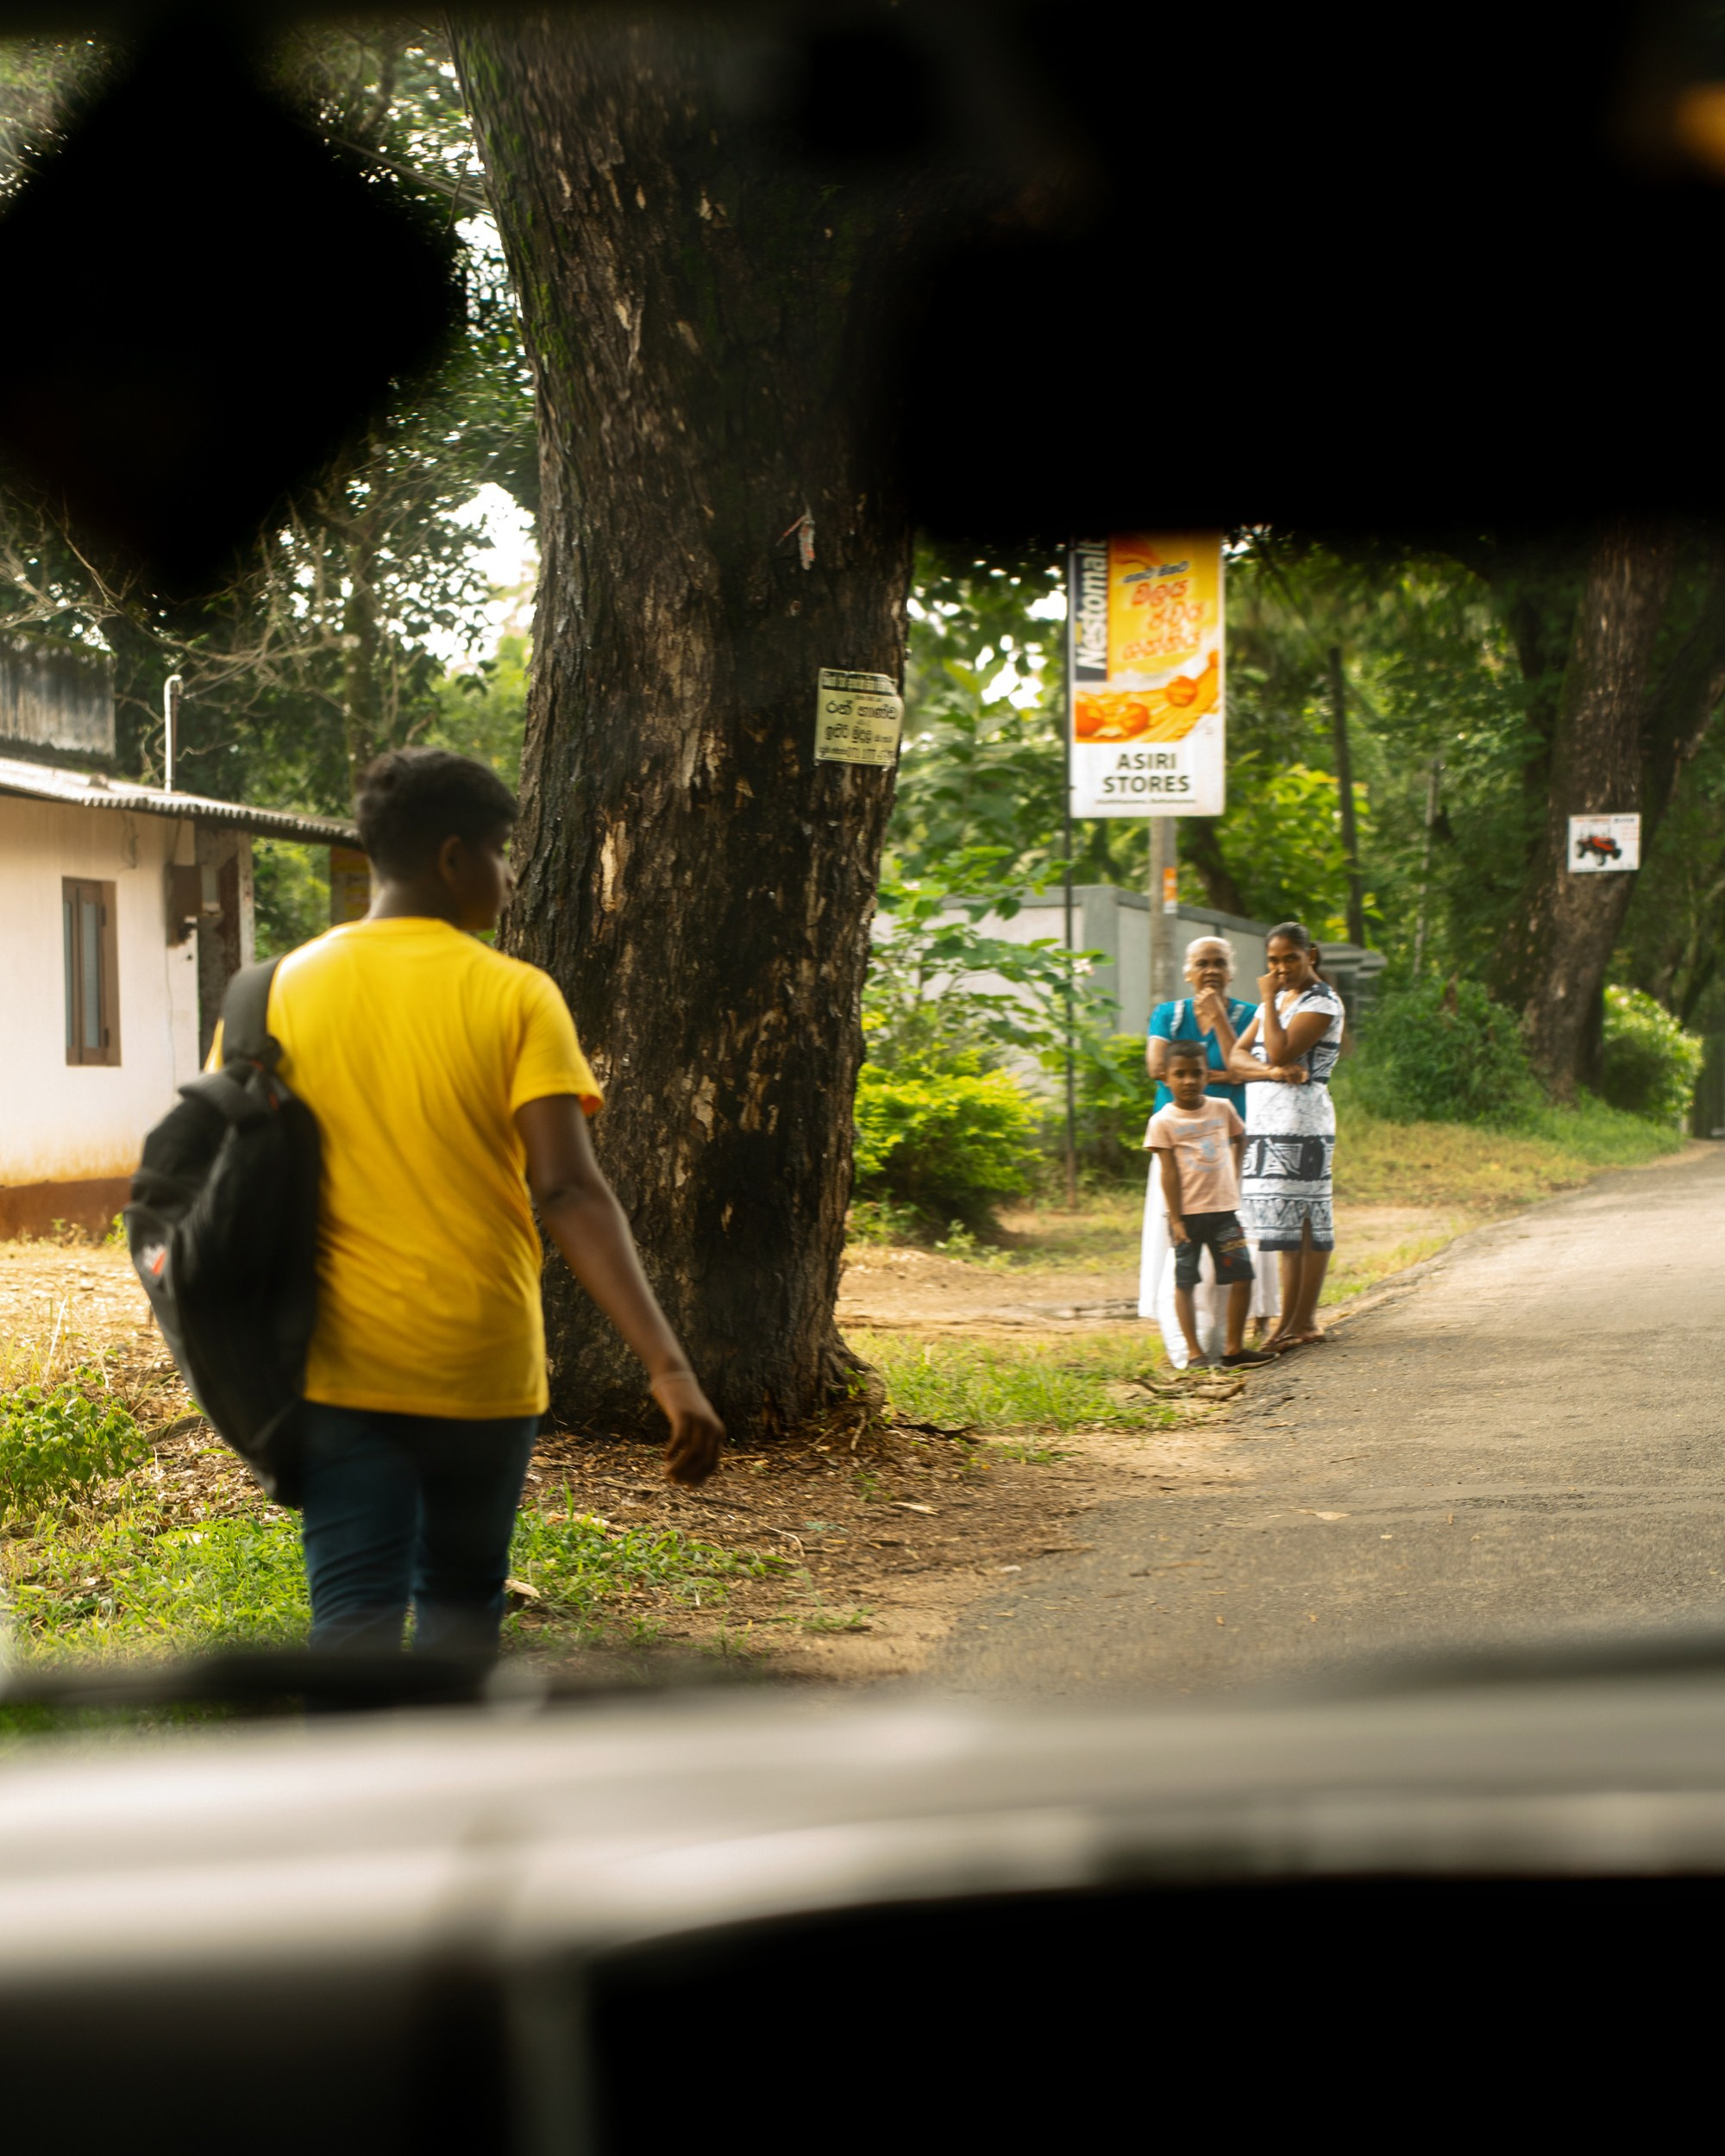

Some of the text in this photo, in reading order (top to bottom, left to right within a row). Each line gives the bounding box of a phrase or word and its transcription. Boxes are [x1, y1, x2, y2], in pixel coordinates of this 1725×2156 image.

[1076, 540, 1107, 669] Nestomalt
[1117, 753, 1176, 770] ASIRI
[1103, 775, 1189, 793] STORES
